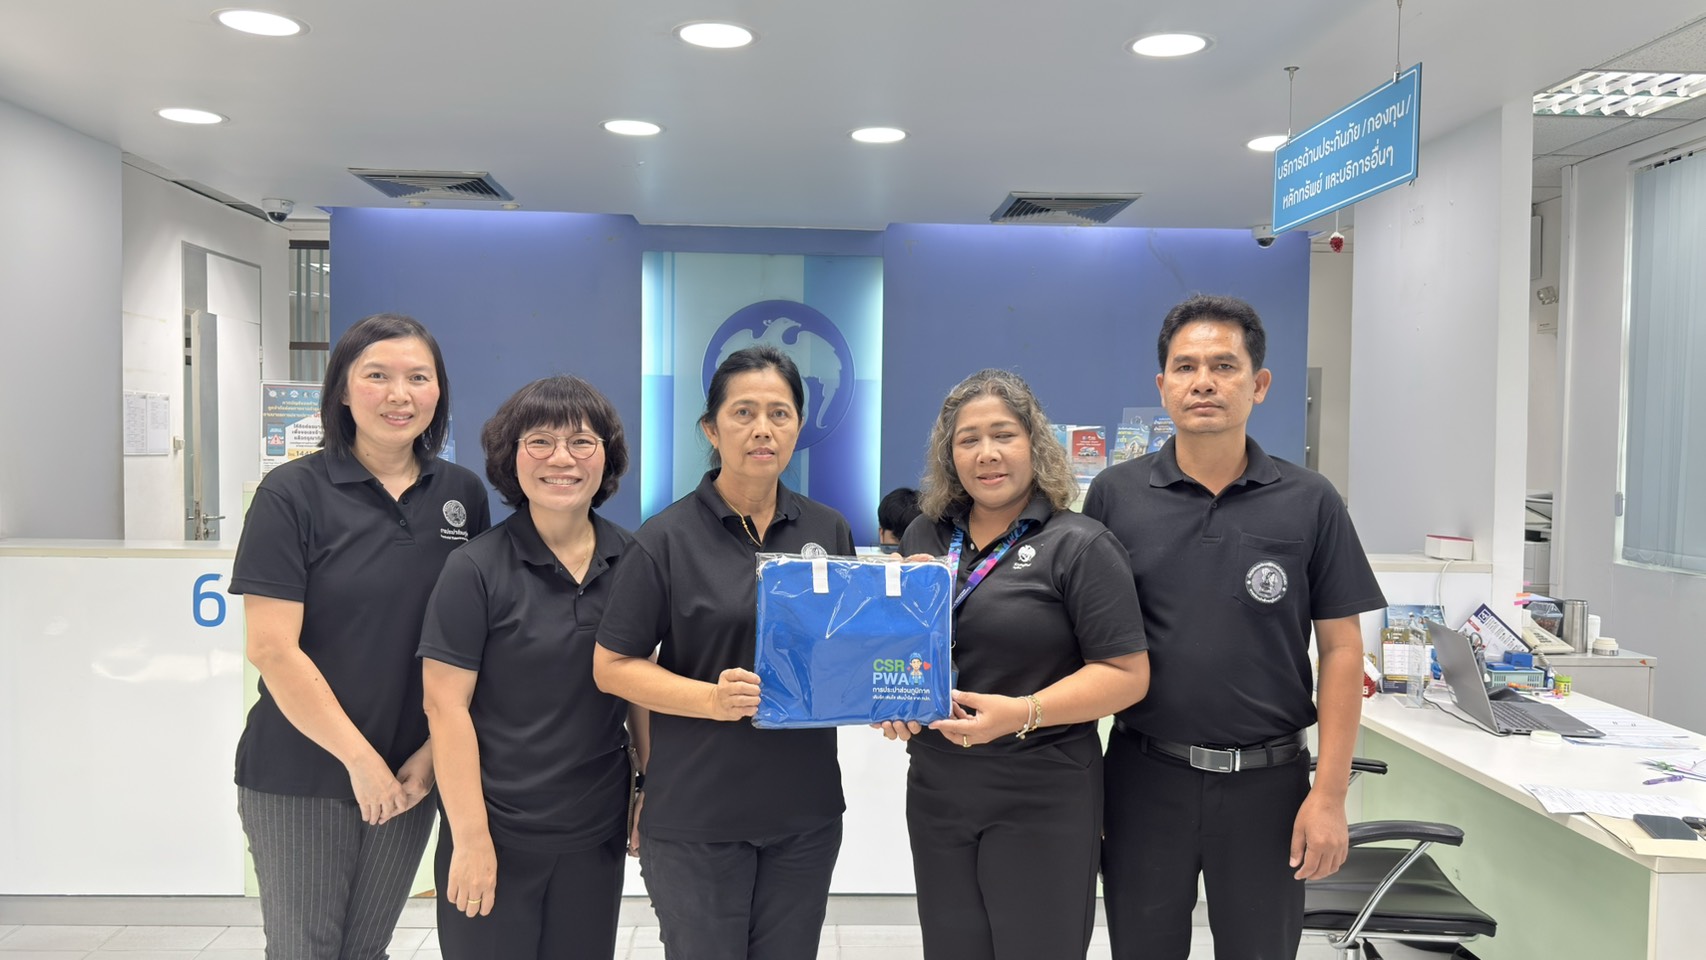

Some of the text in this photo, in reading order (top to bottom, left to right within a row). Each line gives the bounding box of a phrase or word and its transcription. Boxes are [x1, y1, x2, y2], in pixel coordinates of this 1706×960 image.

[1282, 139, 1394, 210] หลักทรัพย์ และบริการอื่นๆ
[192, 573, 226, 628] 6
[872, 672, 909, 685] PWA
[873, 658, 905, 672] CSR
